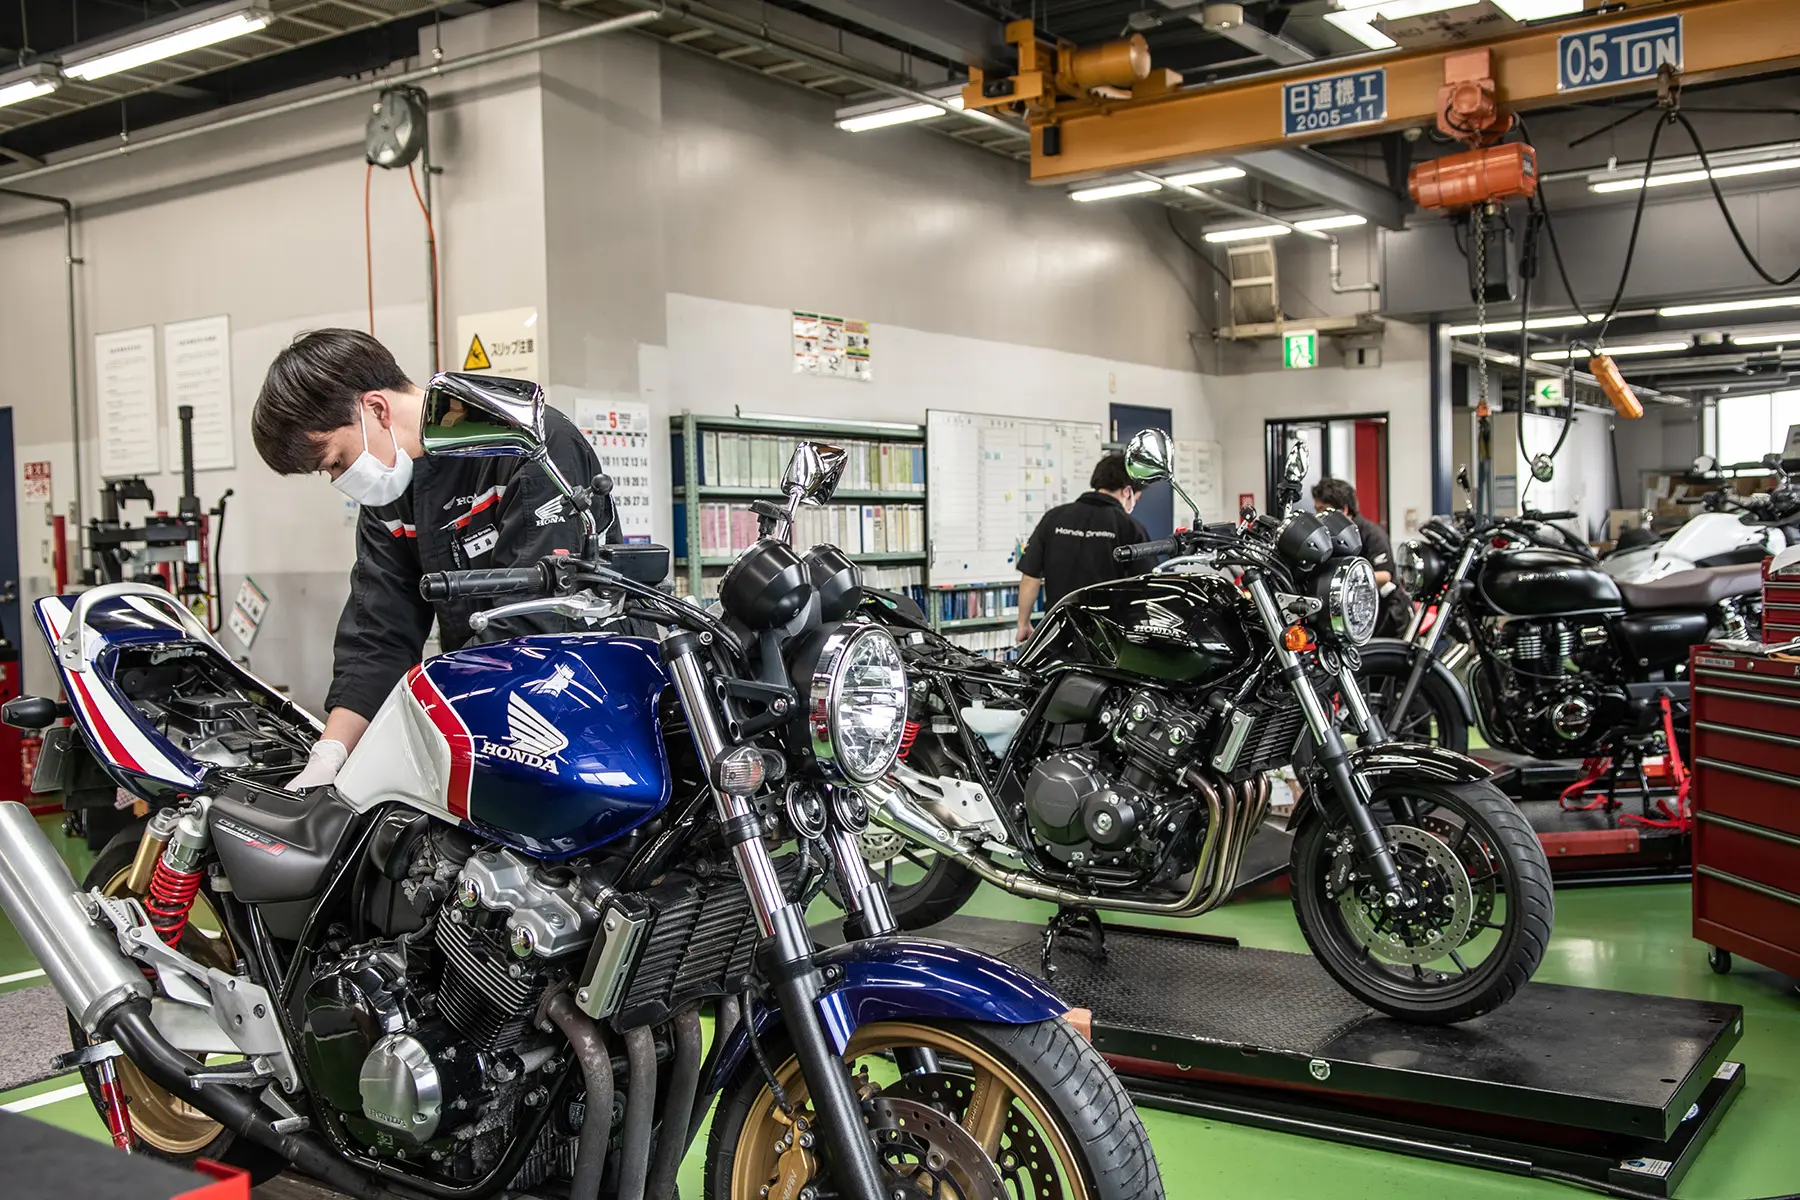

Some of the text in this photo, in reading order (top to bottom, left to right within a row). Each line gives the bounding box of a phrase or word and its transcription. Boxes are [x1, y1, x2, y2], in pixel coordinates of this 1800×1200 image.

[1566, 26, 1677, 85] 0.5 TON
[1290, 74, 1379, 114] 日通機工
[1296, 104, 1374, 131] 2005-11
[490, 338, 534, 357] スリップ注意
[609, 412, 617, 429] 5
[535, 515, 566, 527] HONA
[1055, 527, 1085, 537] Honda
[1133, 624, 1182, 638] HONDA
[480, 738, 560, 776] HONDA
[368, 1108, 407, 1127] HONDA
